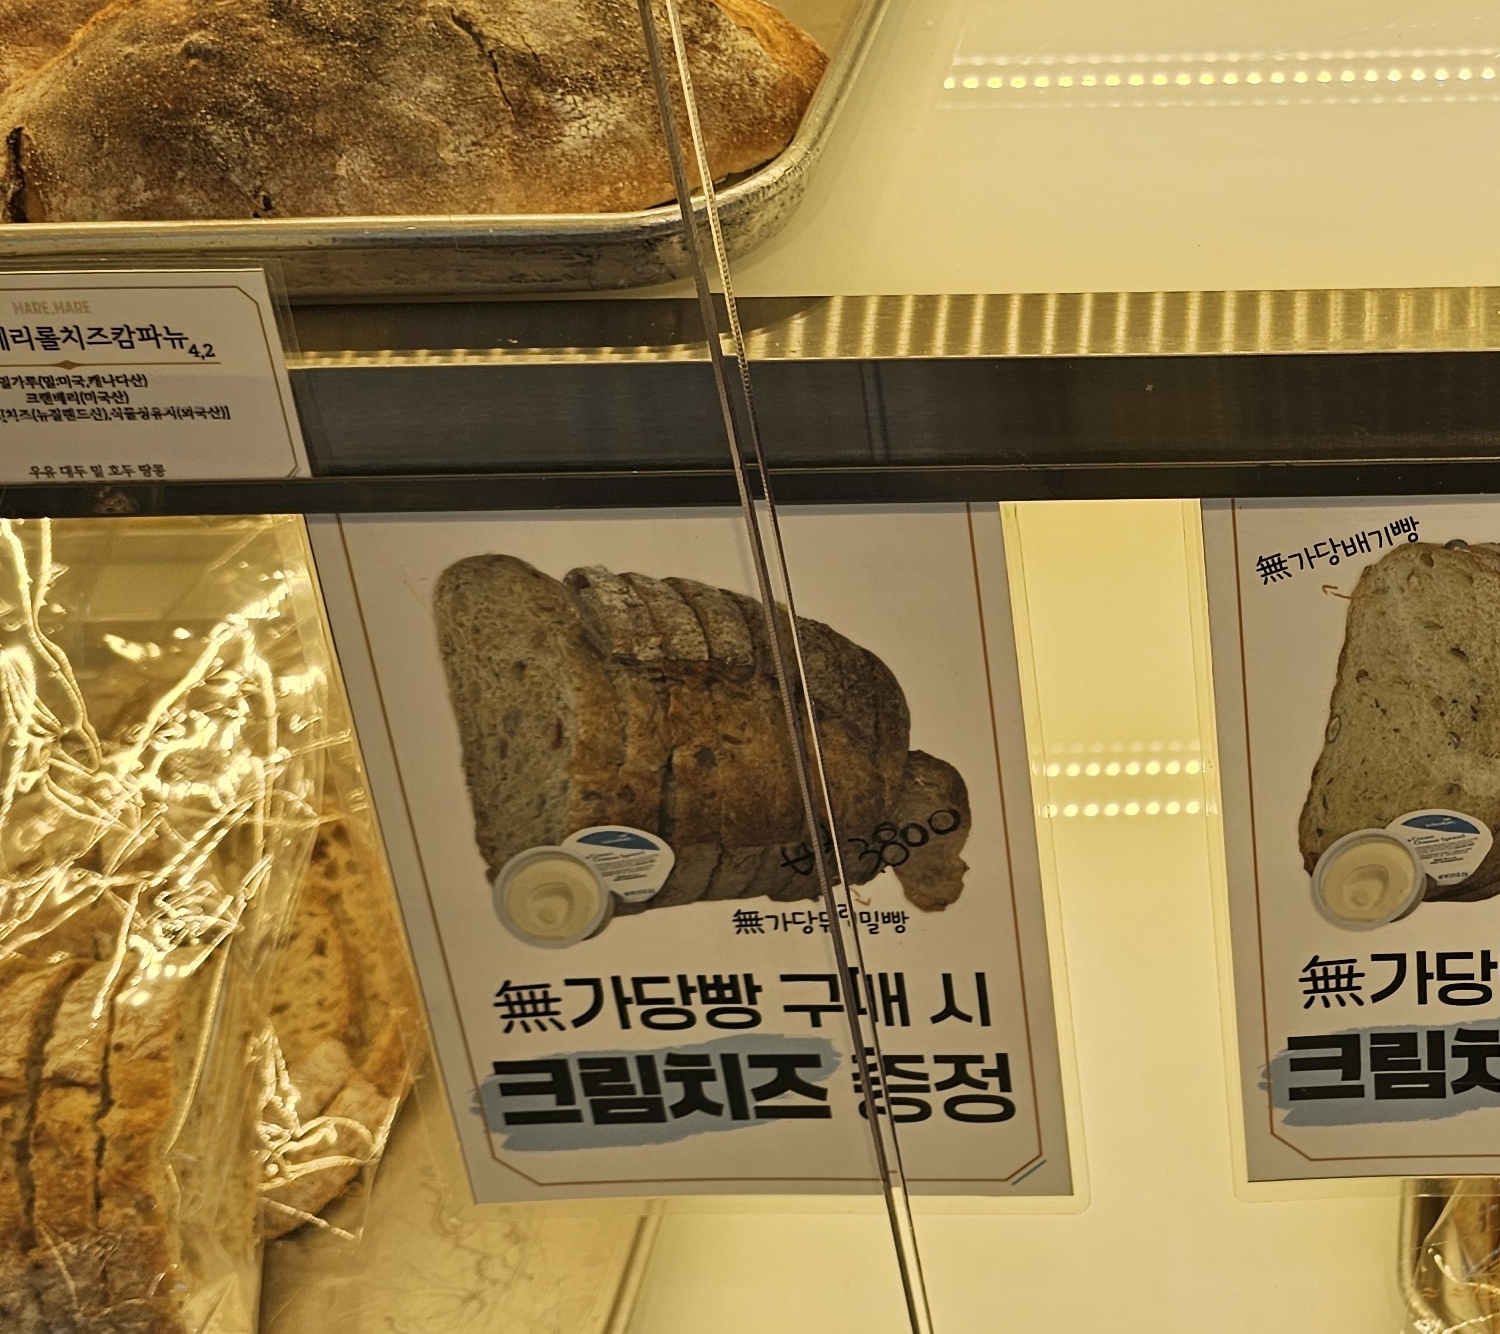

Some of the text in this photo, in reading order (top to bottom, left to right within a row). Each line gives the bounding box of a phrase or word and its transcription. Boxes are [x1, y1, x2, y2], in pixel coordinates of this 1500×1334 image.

[1256, 516, 1420, 585] 無가당배기빵
[494, 967, 991, 1033] 無가당빵 구매 시
[493, 1048, 1015, 1125] 크림치즈 증정
